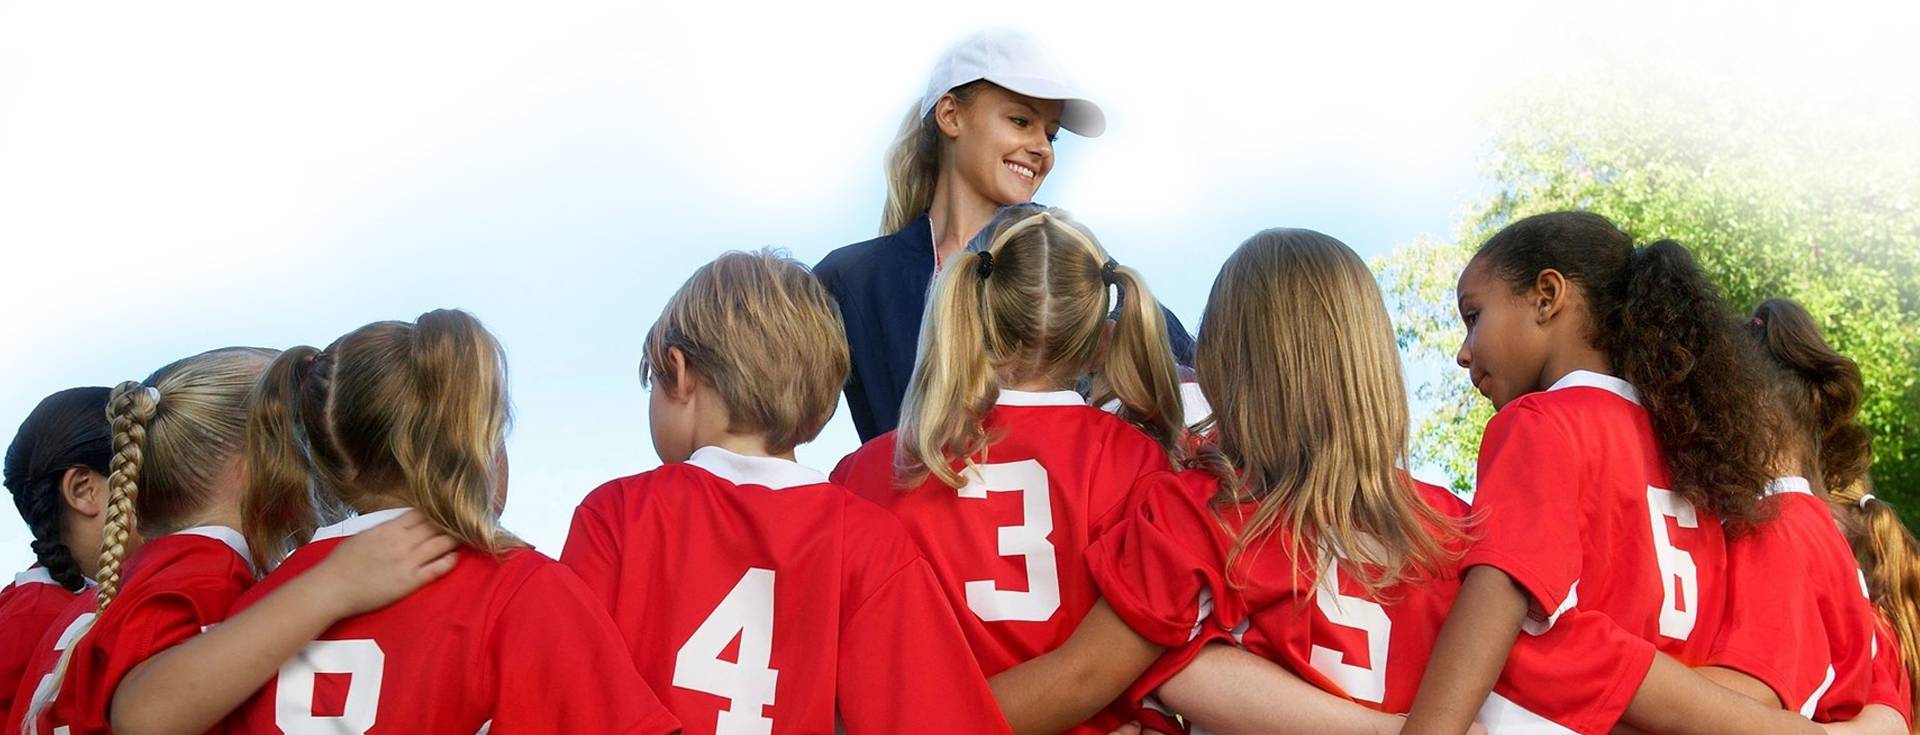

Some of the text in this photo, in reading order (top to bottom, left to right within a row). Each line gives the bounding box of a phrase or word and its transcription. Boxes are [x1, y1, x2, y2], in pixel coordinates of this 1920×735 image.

[957, 459, 1061, 622] 3
[1309, 526, 1392, 704] 5
[1646, 485, 1699, 641] 6
[672, 567, 779, 735] 4
